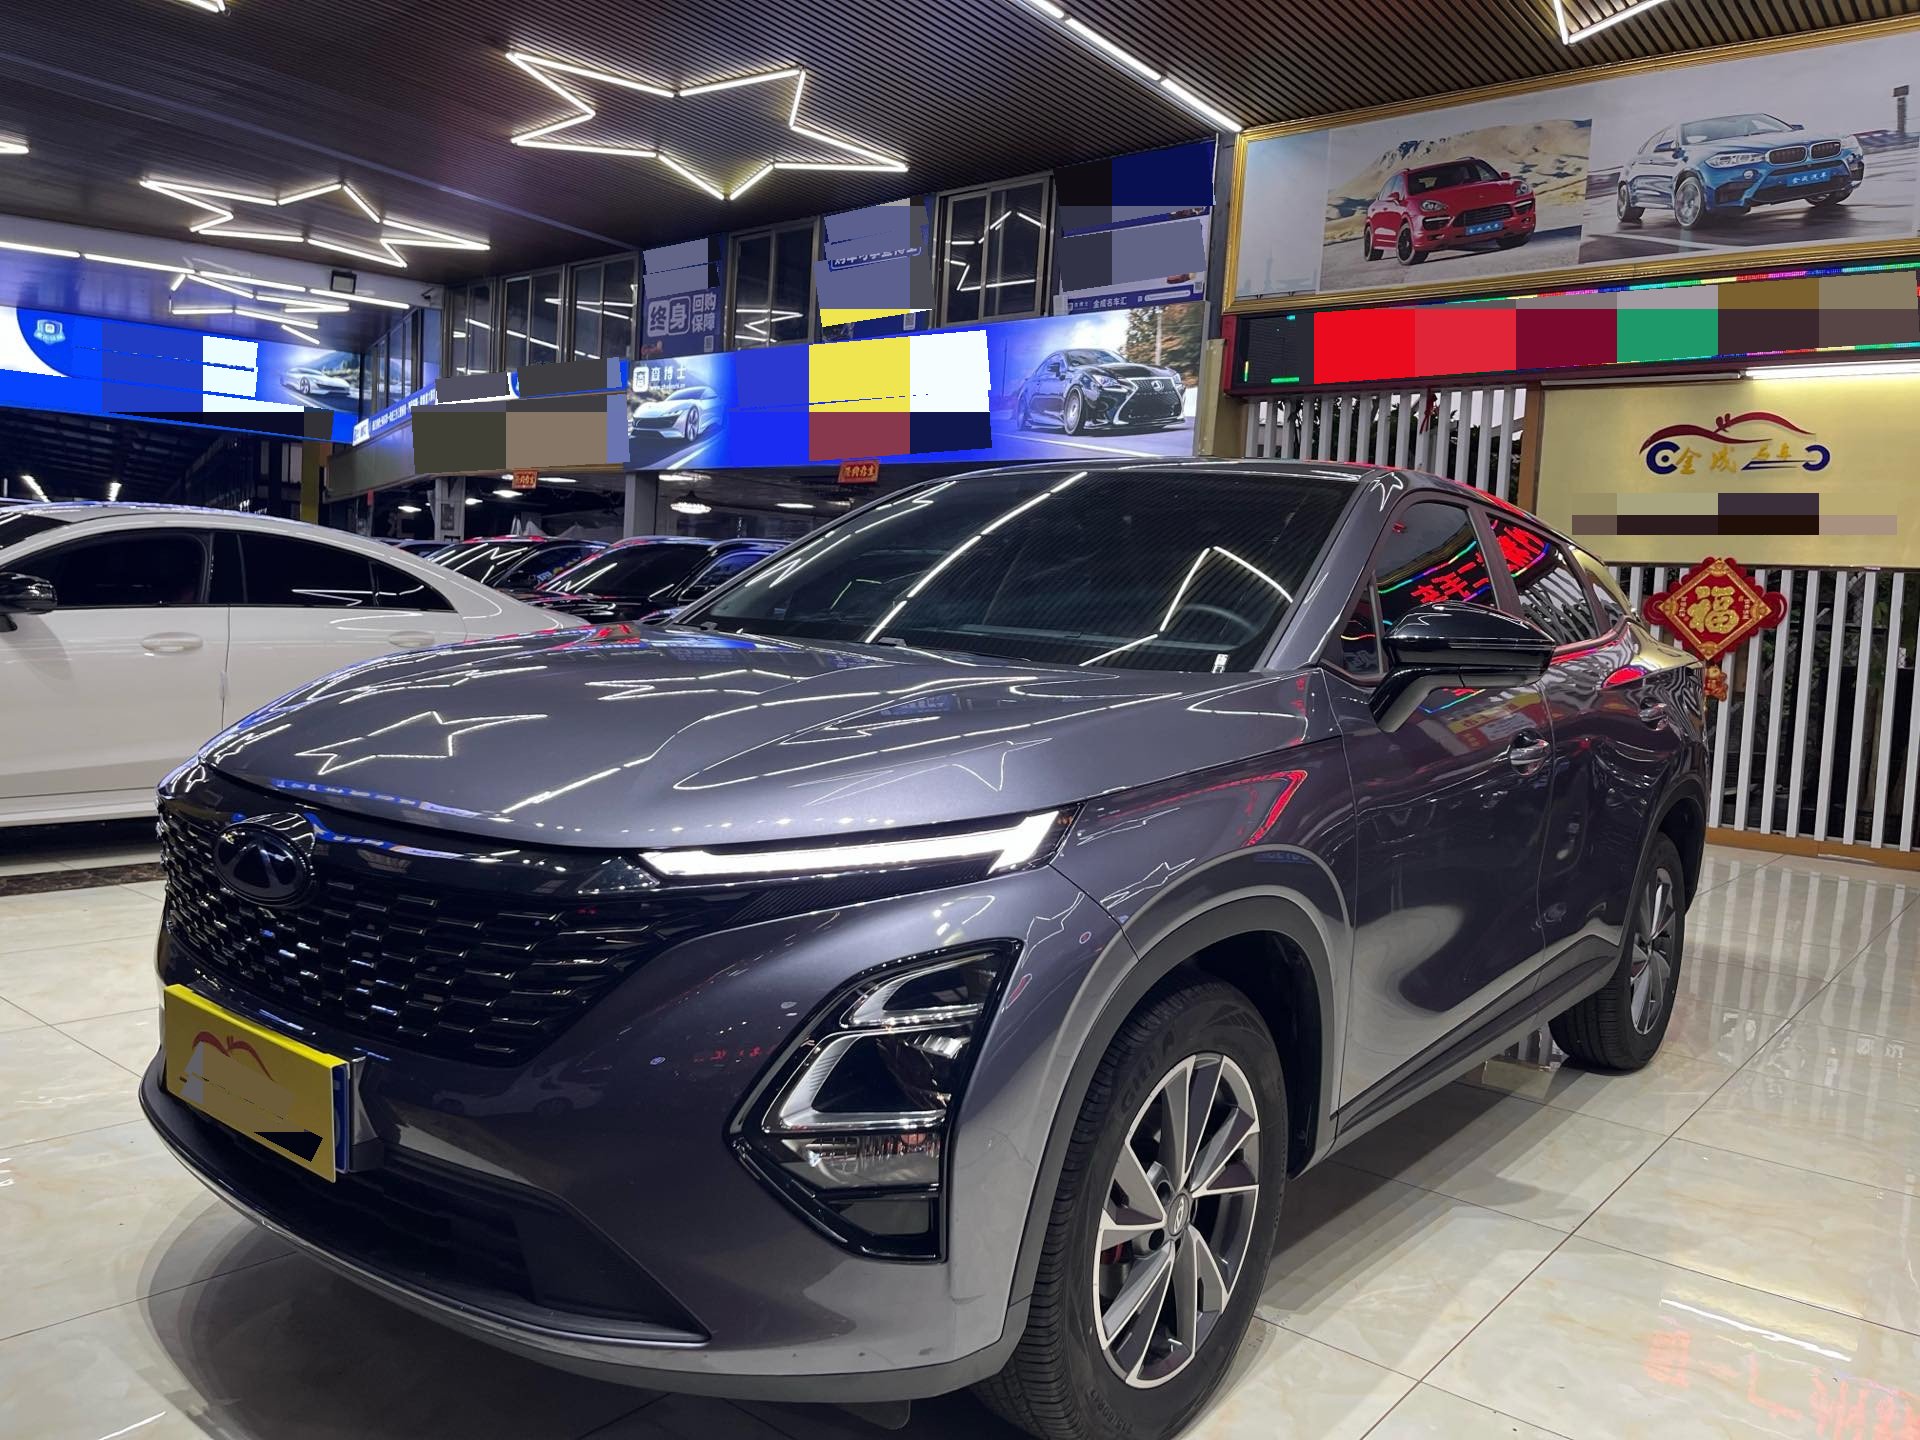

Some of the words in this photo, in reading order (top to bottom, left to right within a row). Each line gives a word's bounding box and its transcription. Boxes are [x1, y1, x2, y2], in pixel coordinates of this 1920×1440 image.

[692, 292, 717, 312] 回购
[1092, 296, 1128, 309] 金成名车汇
[650, 303, 688, 332] 终身
[691, 312, 715, 333] 保障
[1687, 585, 1741, 634] 福
